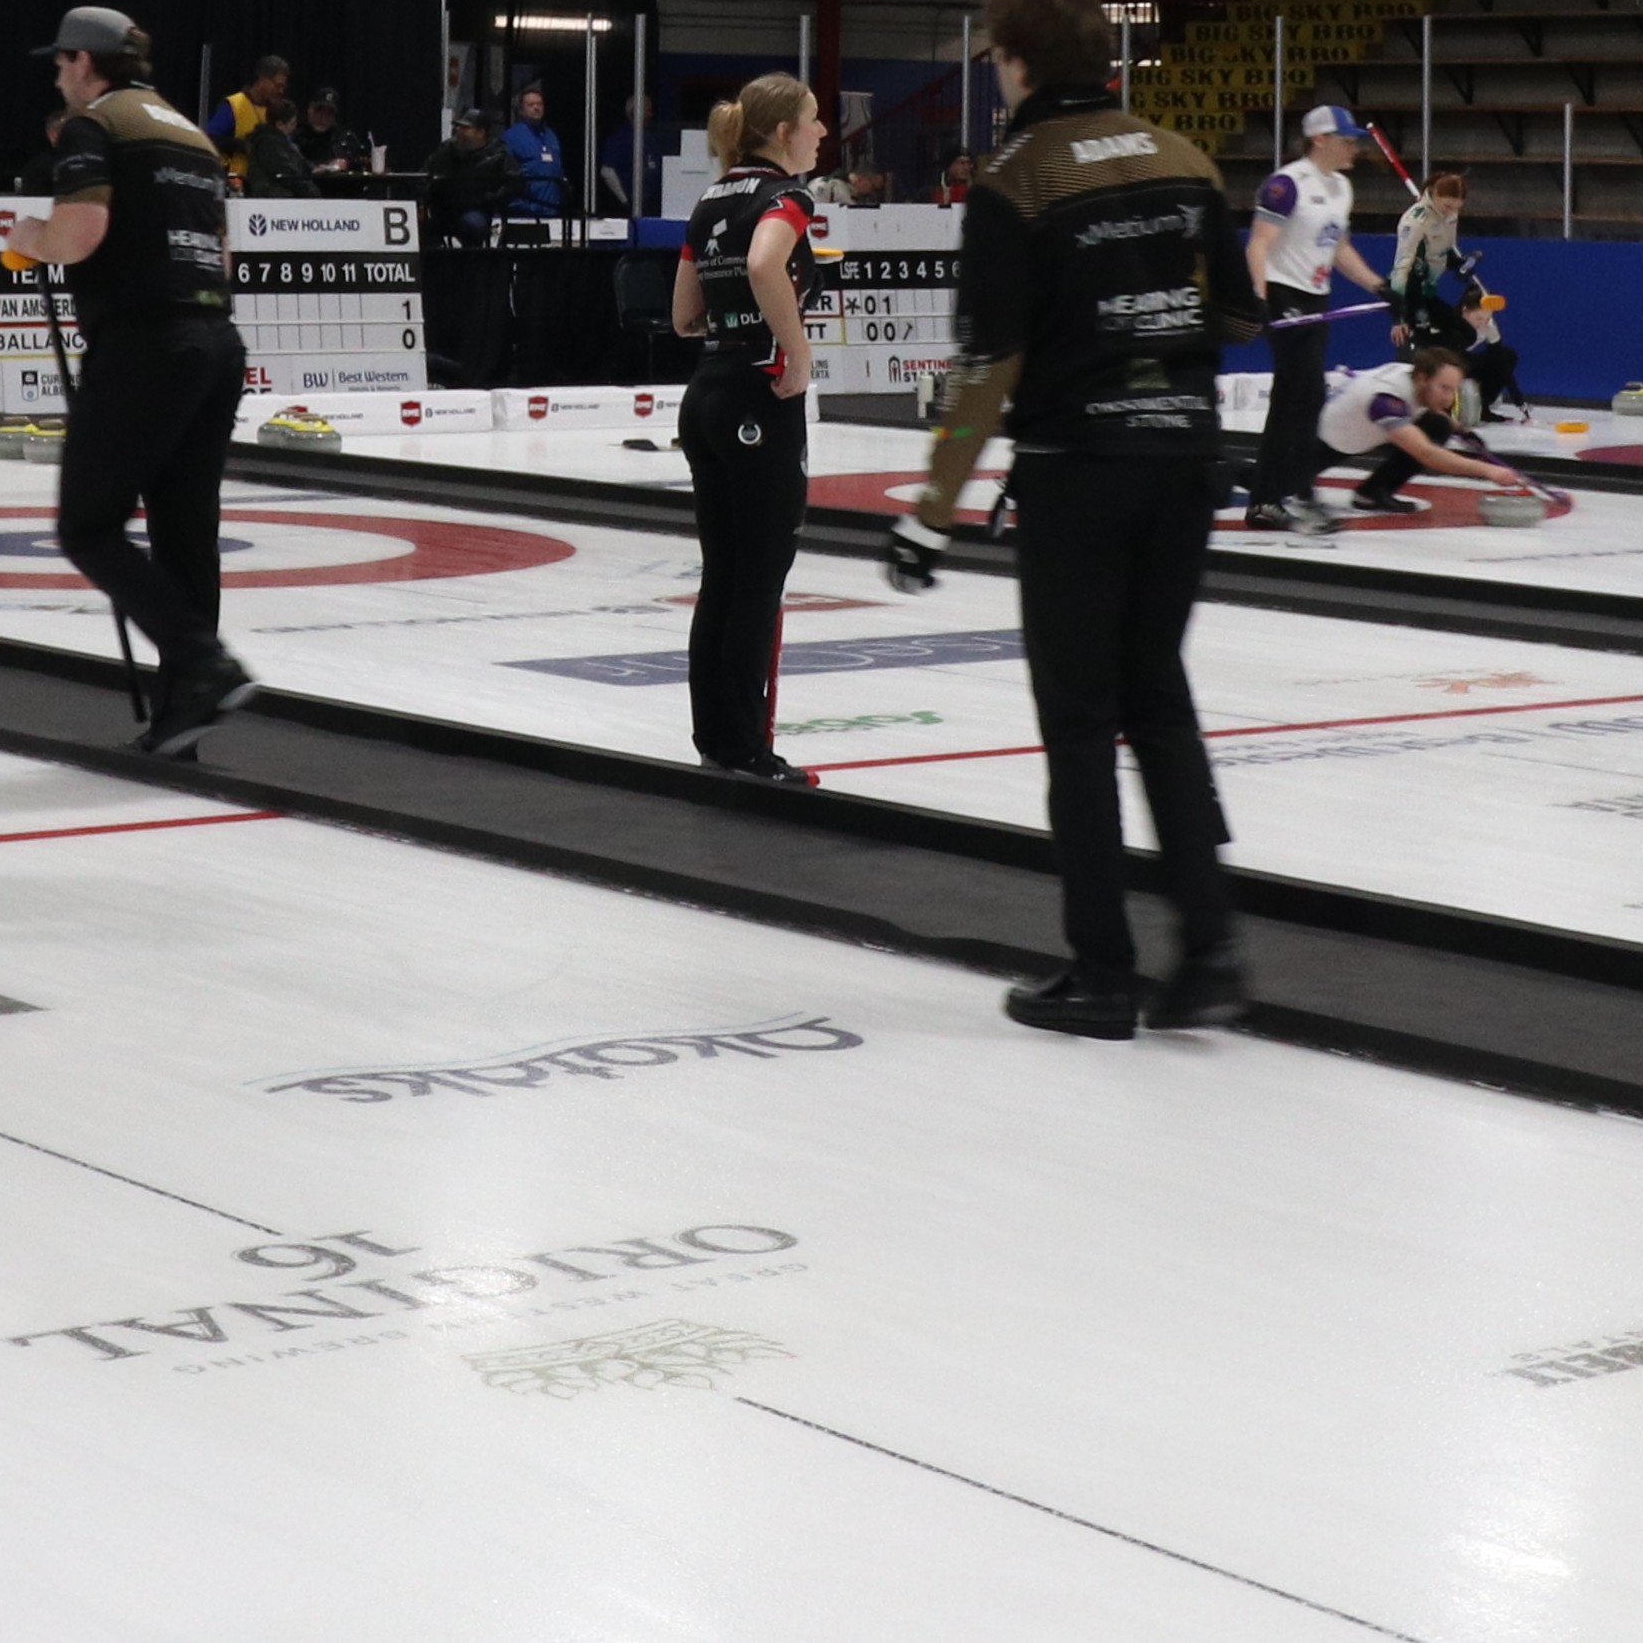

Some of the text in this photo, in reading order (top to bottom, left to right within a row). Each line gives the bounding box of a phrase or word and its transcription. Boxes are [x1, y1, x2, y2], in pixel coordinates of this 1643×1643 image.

[1235, 3, 1279, 22] BIG
[1289, 2, 1346, 21] SKY
[1195, 24, 1240, 43] BIG
[1311, 22, 1376, 41] BBQ
[1170, 46, 1216, 64] BIG
[1179, 67, 1234, 85] SKY
[1152, 91, 1208, 109] SKY
[1173, 113, 1237, 131] BBQ
[271, 220, 360, 232] NEW HOLLAND
[382, 207, 411, 246] B
[237, 262, 416, 283] 6 7 8 9 10 11 TOTAL
[864, 261, 873, 279] 1
[880, 261, 891, 279] 2
[898, 261, 908, 279] 3
[916, 261, 927, 278] 4
[934, 260, 944, 278] 5
[402, 299, 412, 320] 1
[865, 296, 876, 315] 0
[883, 295, 891, 315] 1
[402, 329, 416, 349] 0
[866, 322, 896, 341] 0 0
[303, 371, 328, 389] BW
[338, 370, 409, 382] Best Western
[235, 1229, 422, 1282] 16
[3, 1223, 803, 1362] ORIGINAL
[172, 1329, 410, 1376] BREWING
